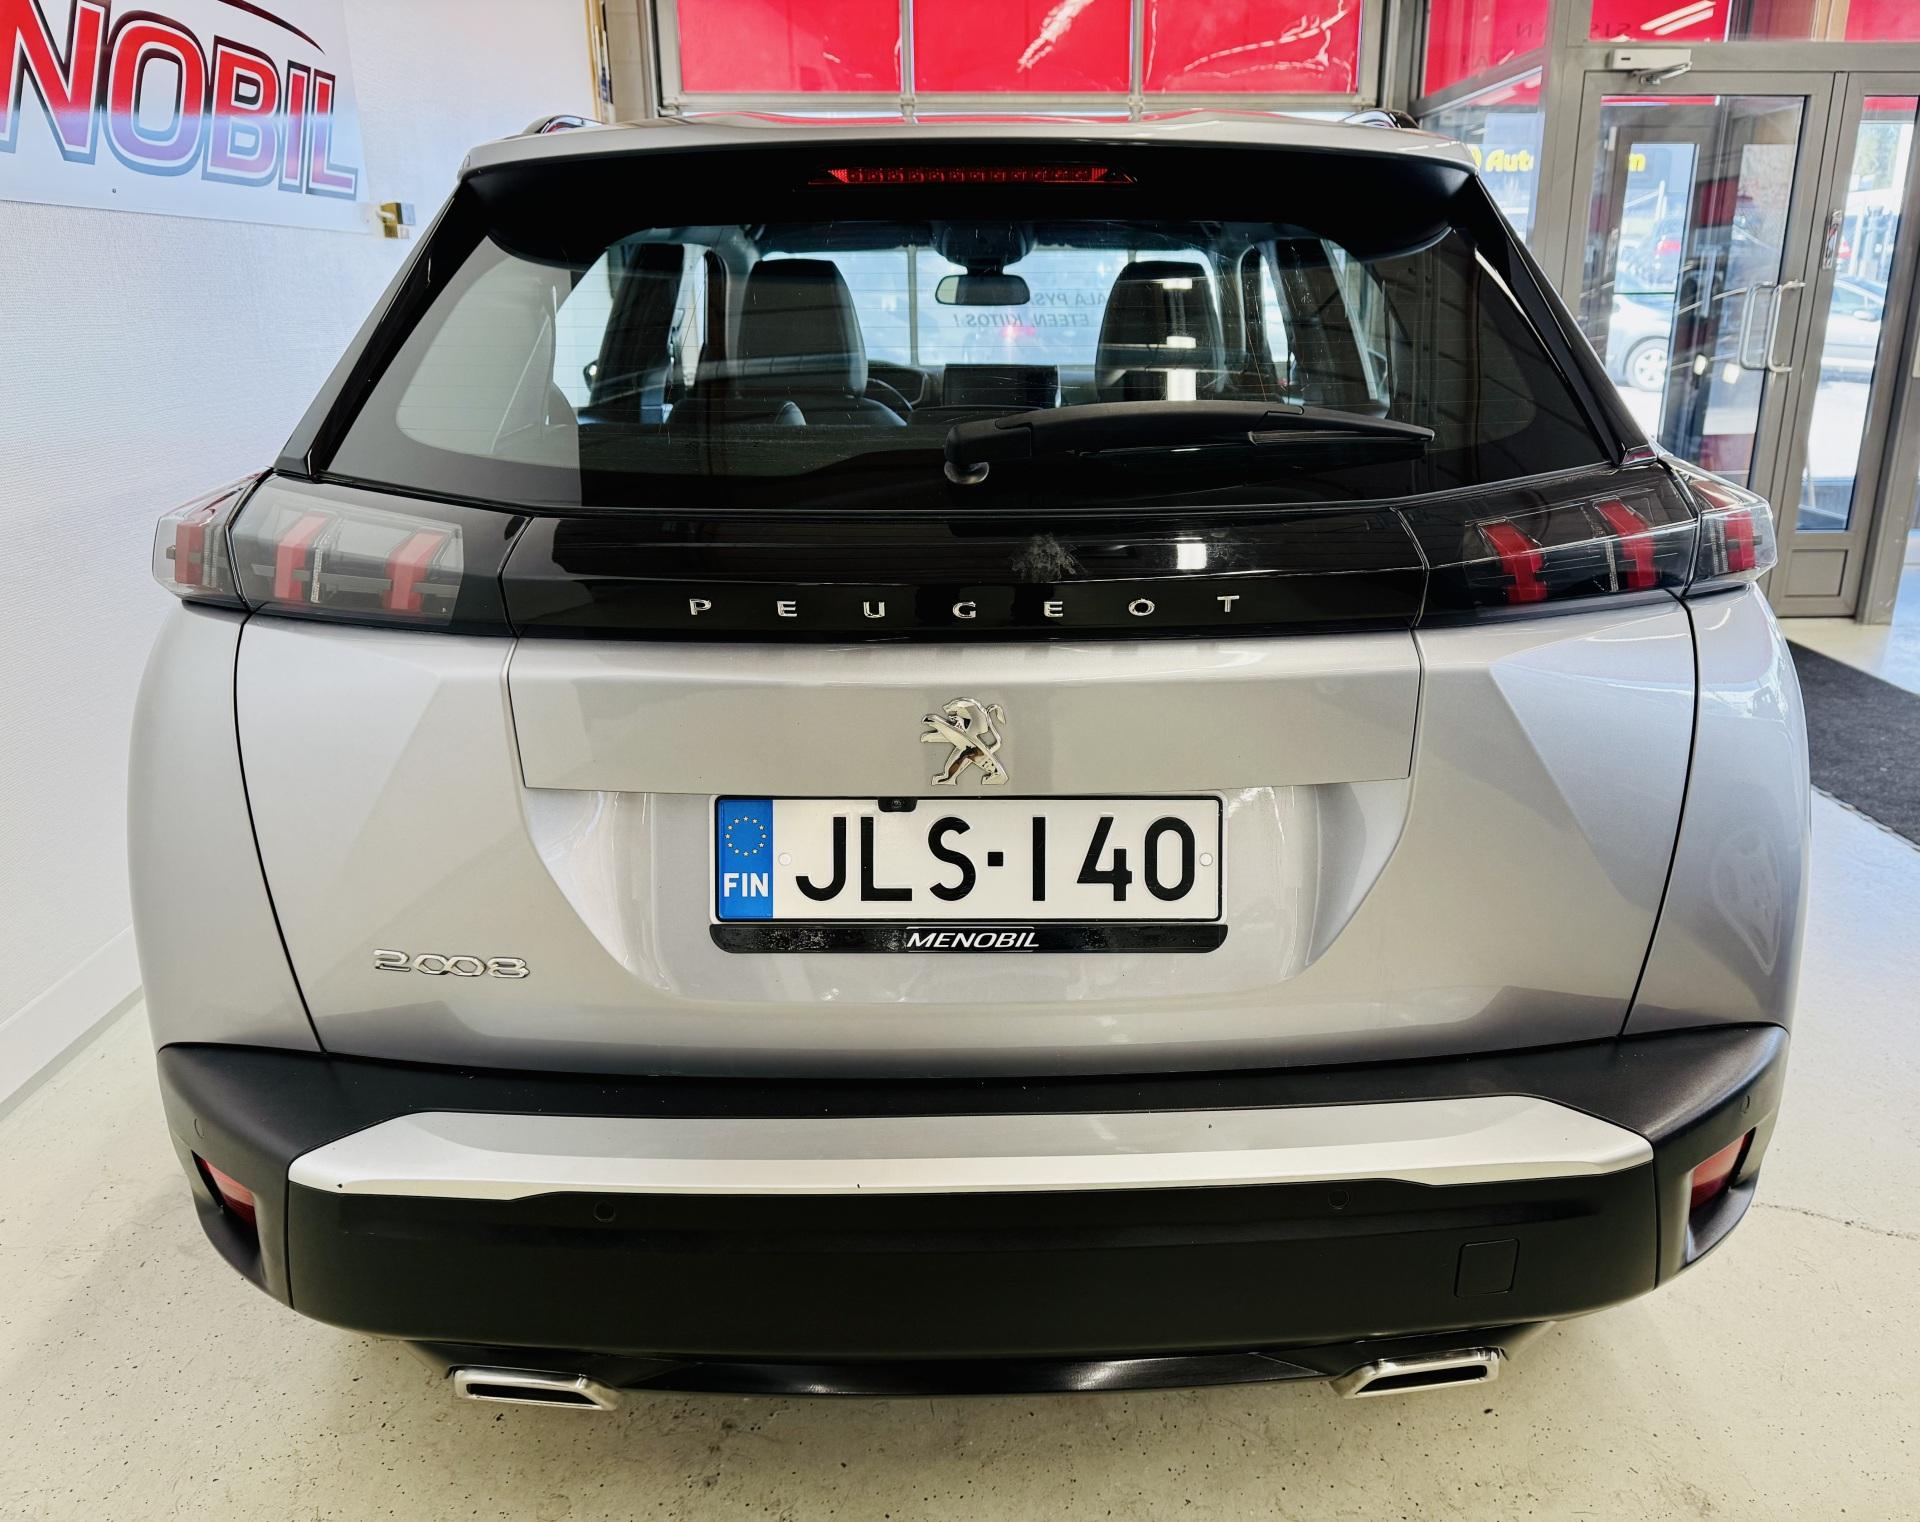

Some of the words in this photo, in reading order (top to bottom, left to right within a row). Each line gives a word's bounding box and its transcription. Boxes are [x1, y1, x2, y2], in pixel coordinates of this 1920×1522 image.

[688, 594, 1241, 619] PEUGEOT
[723, 872, 769, 898] FIN
[906, 932, 1040, 948] MENOBIL
[372, 948, 531, 979] 2008
